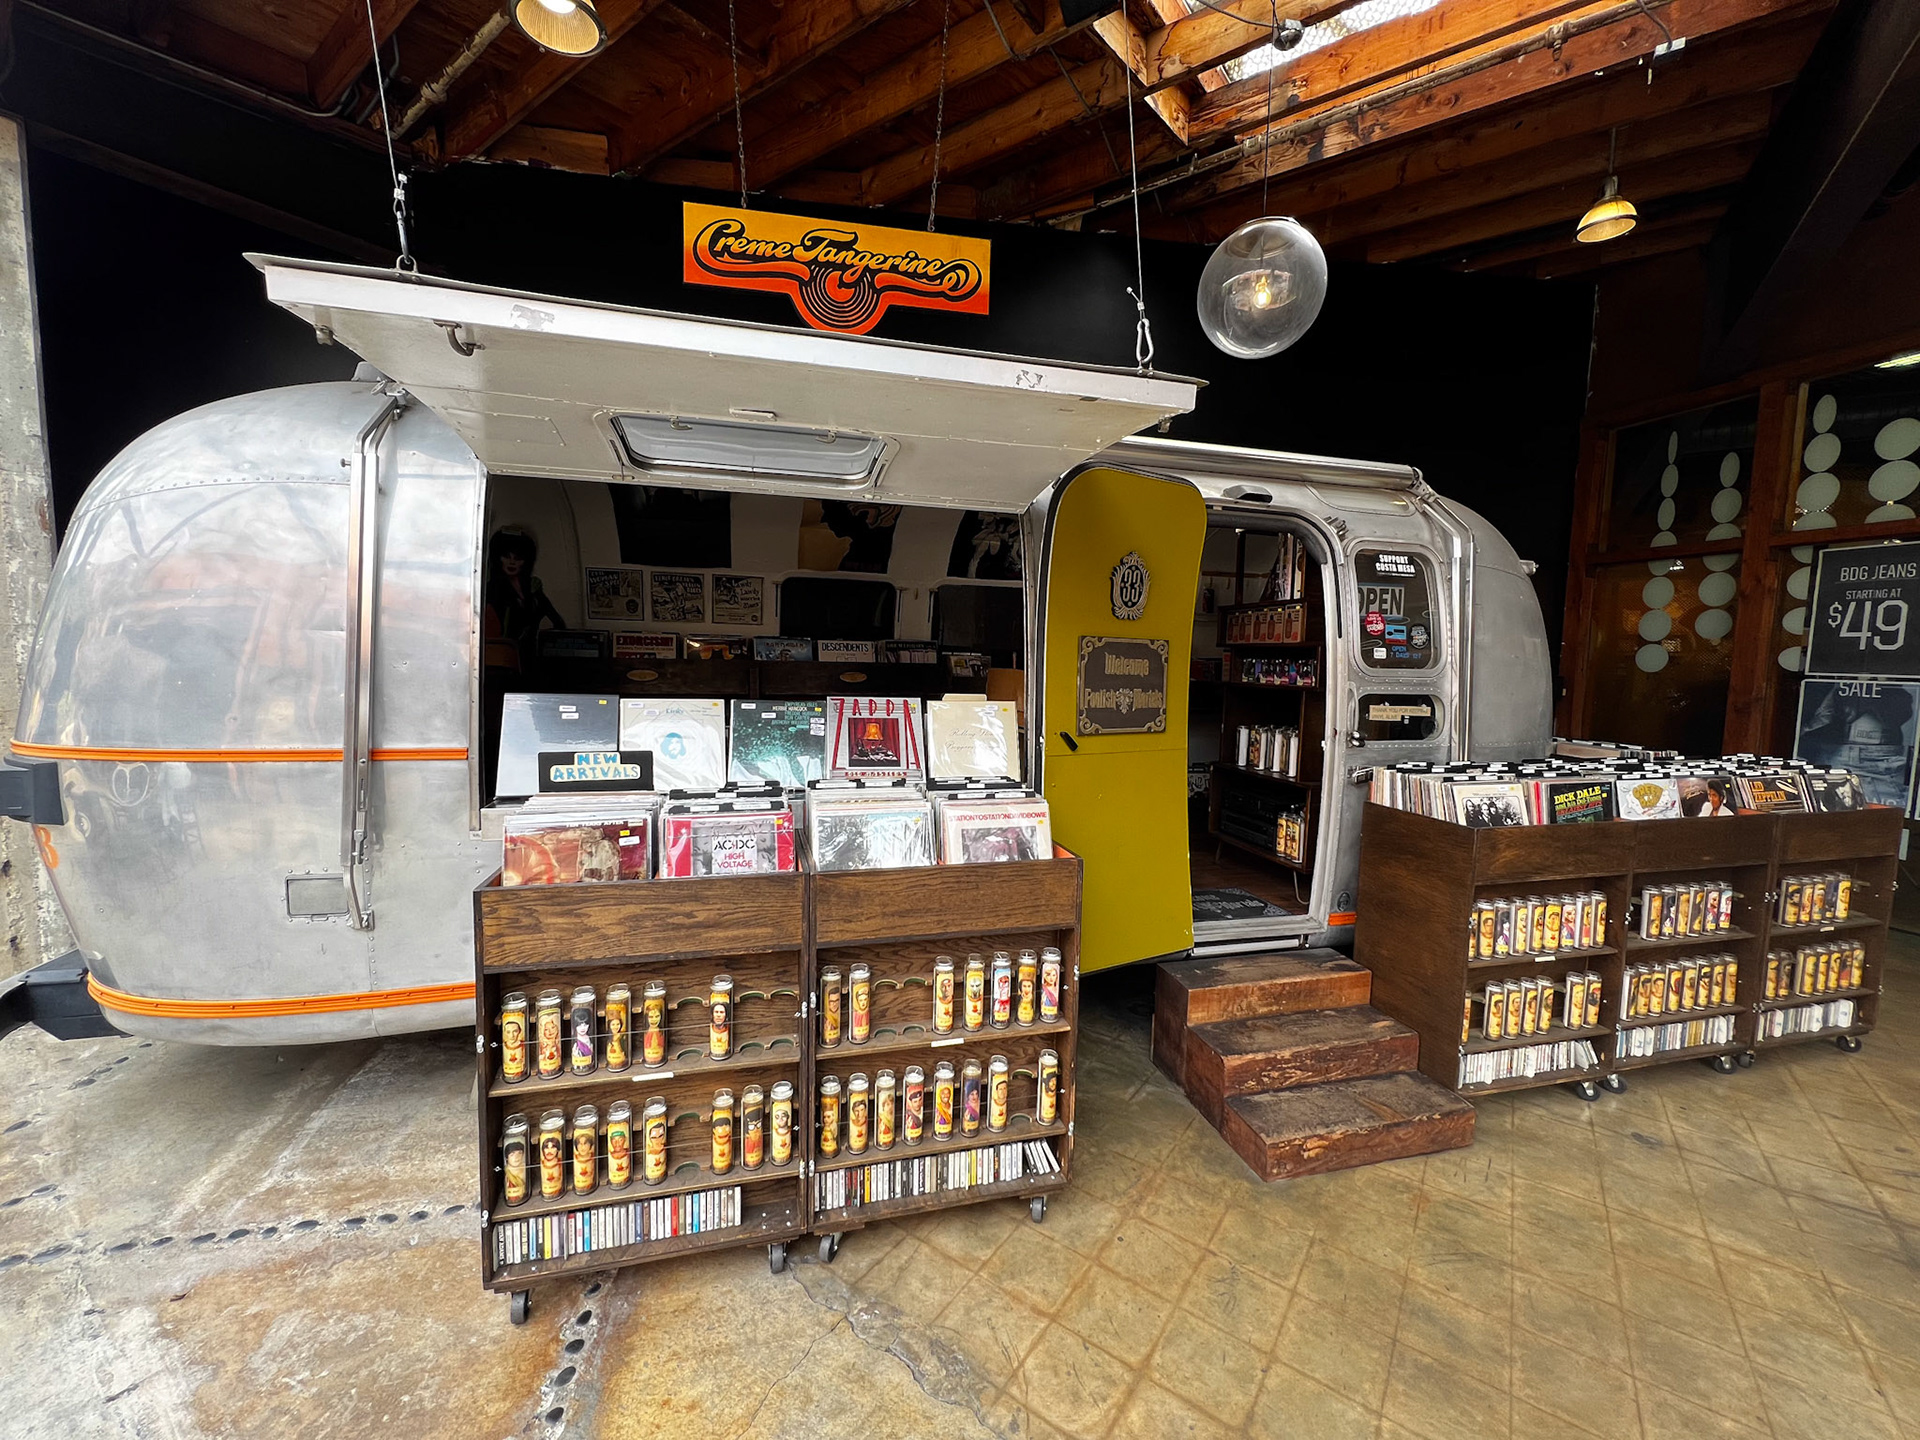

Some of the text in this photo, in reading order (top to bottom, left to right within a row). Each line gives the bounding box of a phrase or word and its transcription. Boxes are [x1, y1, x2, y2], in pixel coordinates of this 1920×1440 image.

[793, 228, 979, 294] Tangerine
[1379, 554, 1409, 564] SUPPORT
[1376, 562, 1416, 573] COSTA MESA
[1840, 562, 1917, 582] BDG JEANS
[1122, 569, 1141, 603] 33
[1845, 588, 1902, 600] STARTING AT
[1827, 599, 1909, 651] $49
[821, 642, 870, 652] DESCENDENTS
[1105, 652, 1149, 677] Welcome
[1838, 682, 1882, 698] SALE
[1085, 688, 1117, 711] Foolish
[830, 697, 921, 770] ZAPPA
[577, 753, 618, 766] NEW
[552, 765, 639, 781] ARRIVALS
[1553, 785, 1602, 805] DICK DALE
[716, 860, 753, 869] VOLTAGE
[724, 852, 745, 861] HIGH
